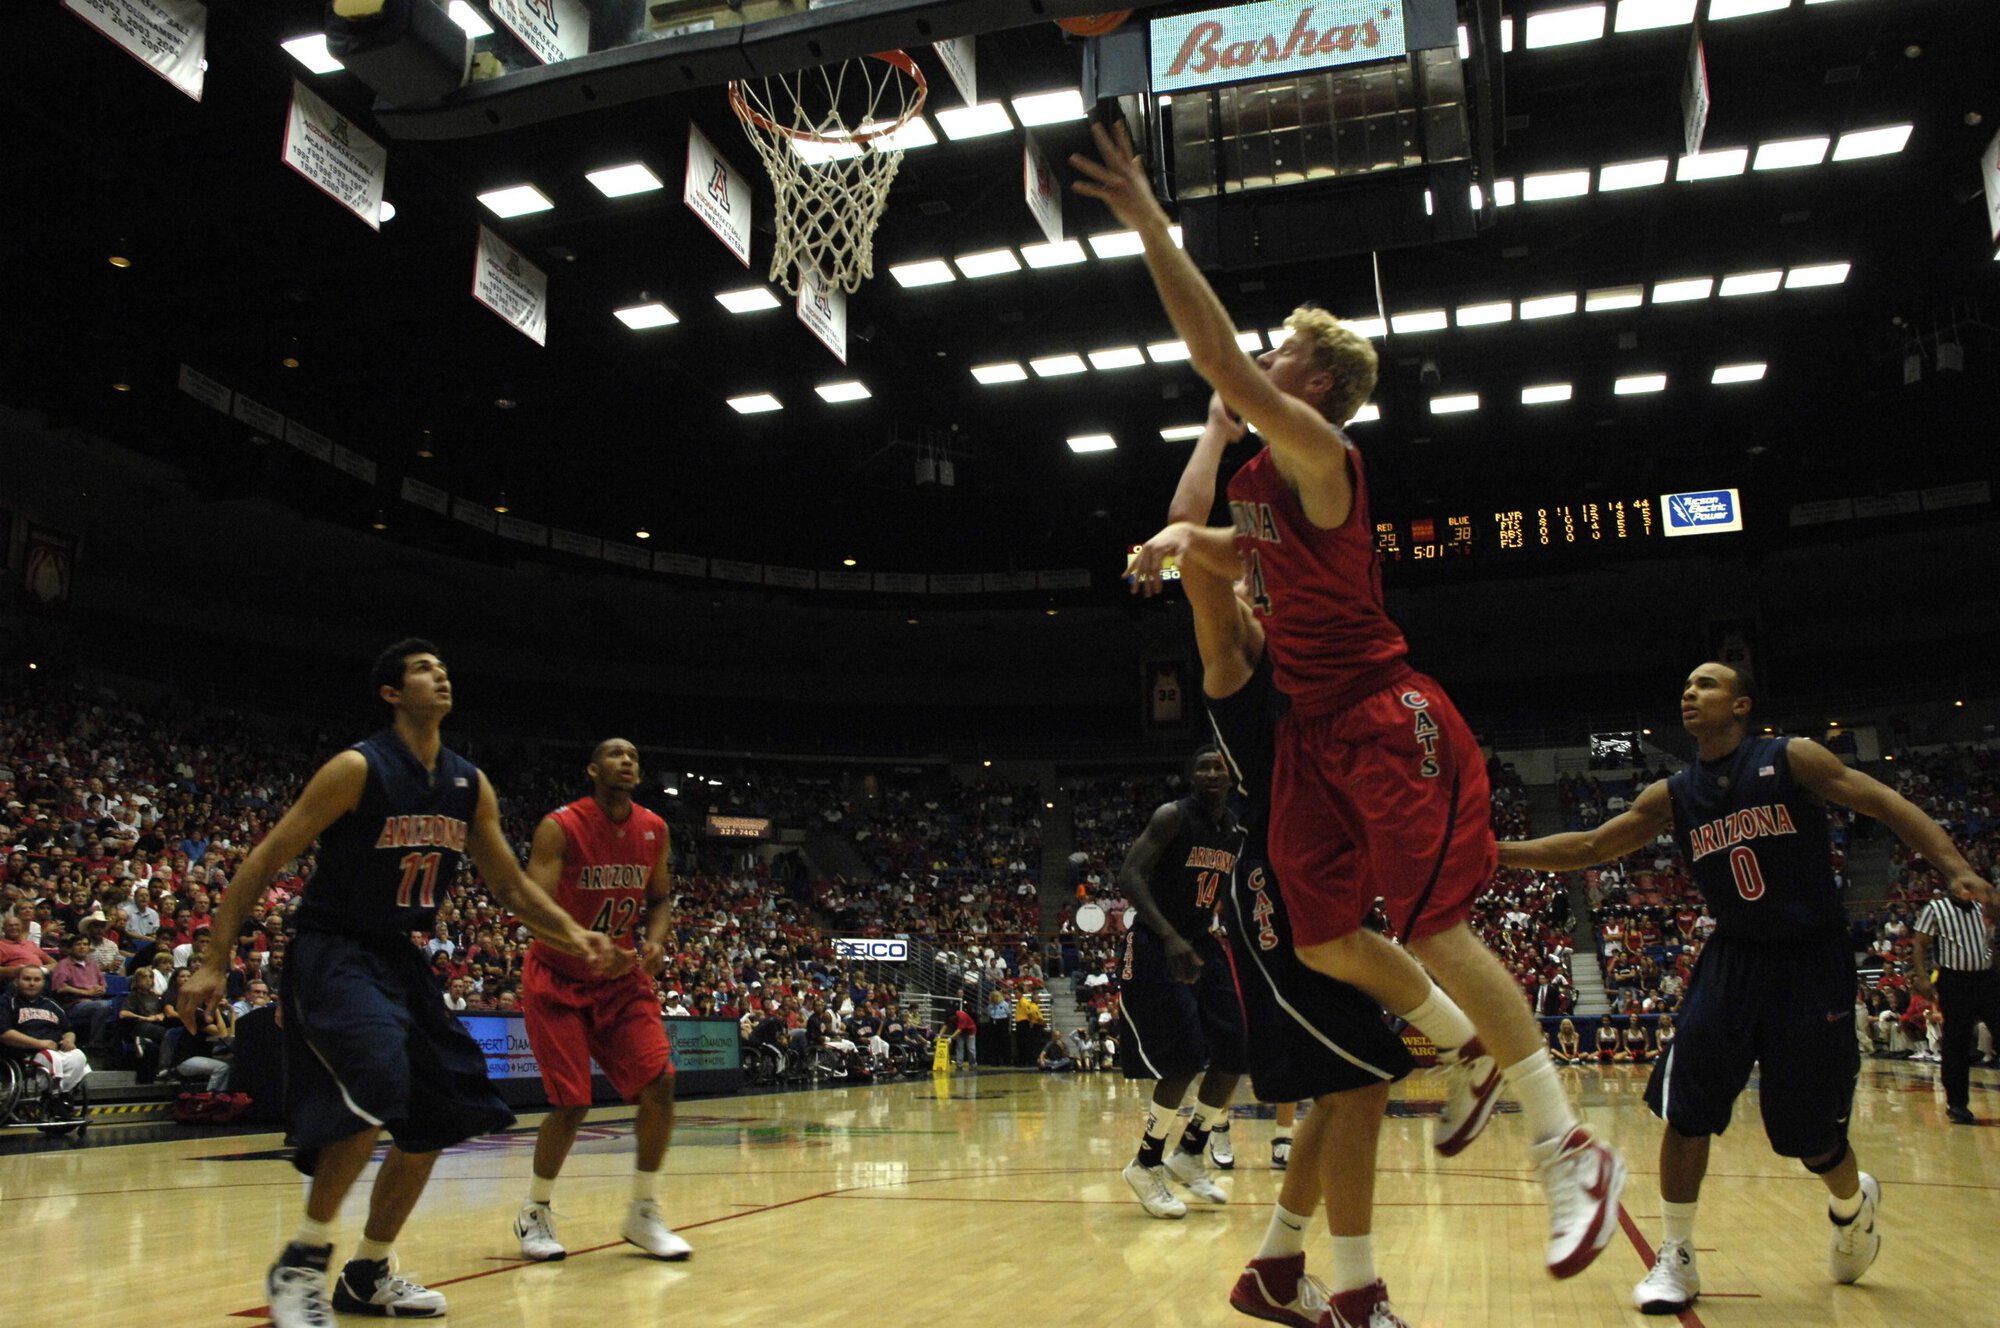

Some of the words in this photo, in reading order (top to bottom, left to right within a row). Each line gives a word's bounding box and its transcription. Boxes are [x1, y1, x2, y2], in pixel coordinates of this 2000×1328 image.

[112, 14, 135, 37] 2006
[127, 16, 150, 38] 2003
[519, 23, 545, 54] SWEET
[1166, 8, 1392, 77] Bashas'
[305, 134, 323, 153] NCAA
[326, 150, 370, 186] TOURNAMENT
[704, 208, 722, 232] SWEET
[1495, 511, 1523, 522] PLYR
[1633, 499, 1649, 508] 44
[1683, 497, 1719, 506] Tucson
[1688, 503, 1727, 514] Electric
[1376, 523, 1393, 532] RED
[1448, 515, 1470, 526] BLUE
[1500, 520, 1520, 531] PTS
[1693, 512, 1729, 521] Power
[1379, 533, 1396, 547] 29
[1453, 526, 1471, 540] 38
[1414, 544, 1444, 560] 5:01
[1158, 688, 1176, 702] 32
[1401, 691, 1440, 778] CATS
[1690, 804, 1798, 862] ARIZONA
[396, 851, 443, 908] 11
[578, 864, 650, 890] ARIZON
[1730, 846, 1765, 901] 0
[1195, 871, 1219, 908] 14
[589, 897, 637, 939] 42
[1248, 867, 1279, 950] CATS
[1402, 1037, 1430, 1046] WEL
